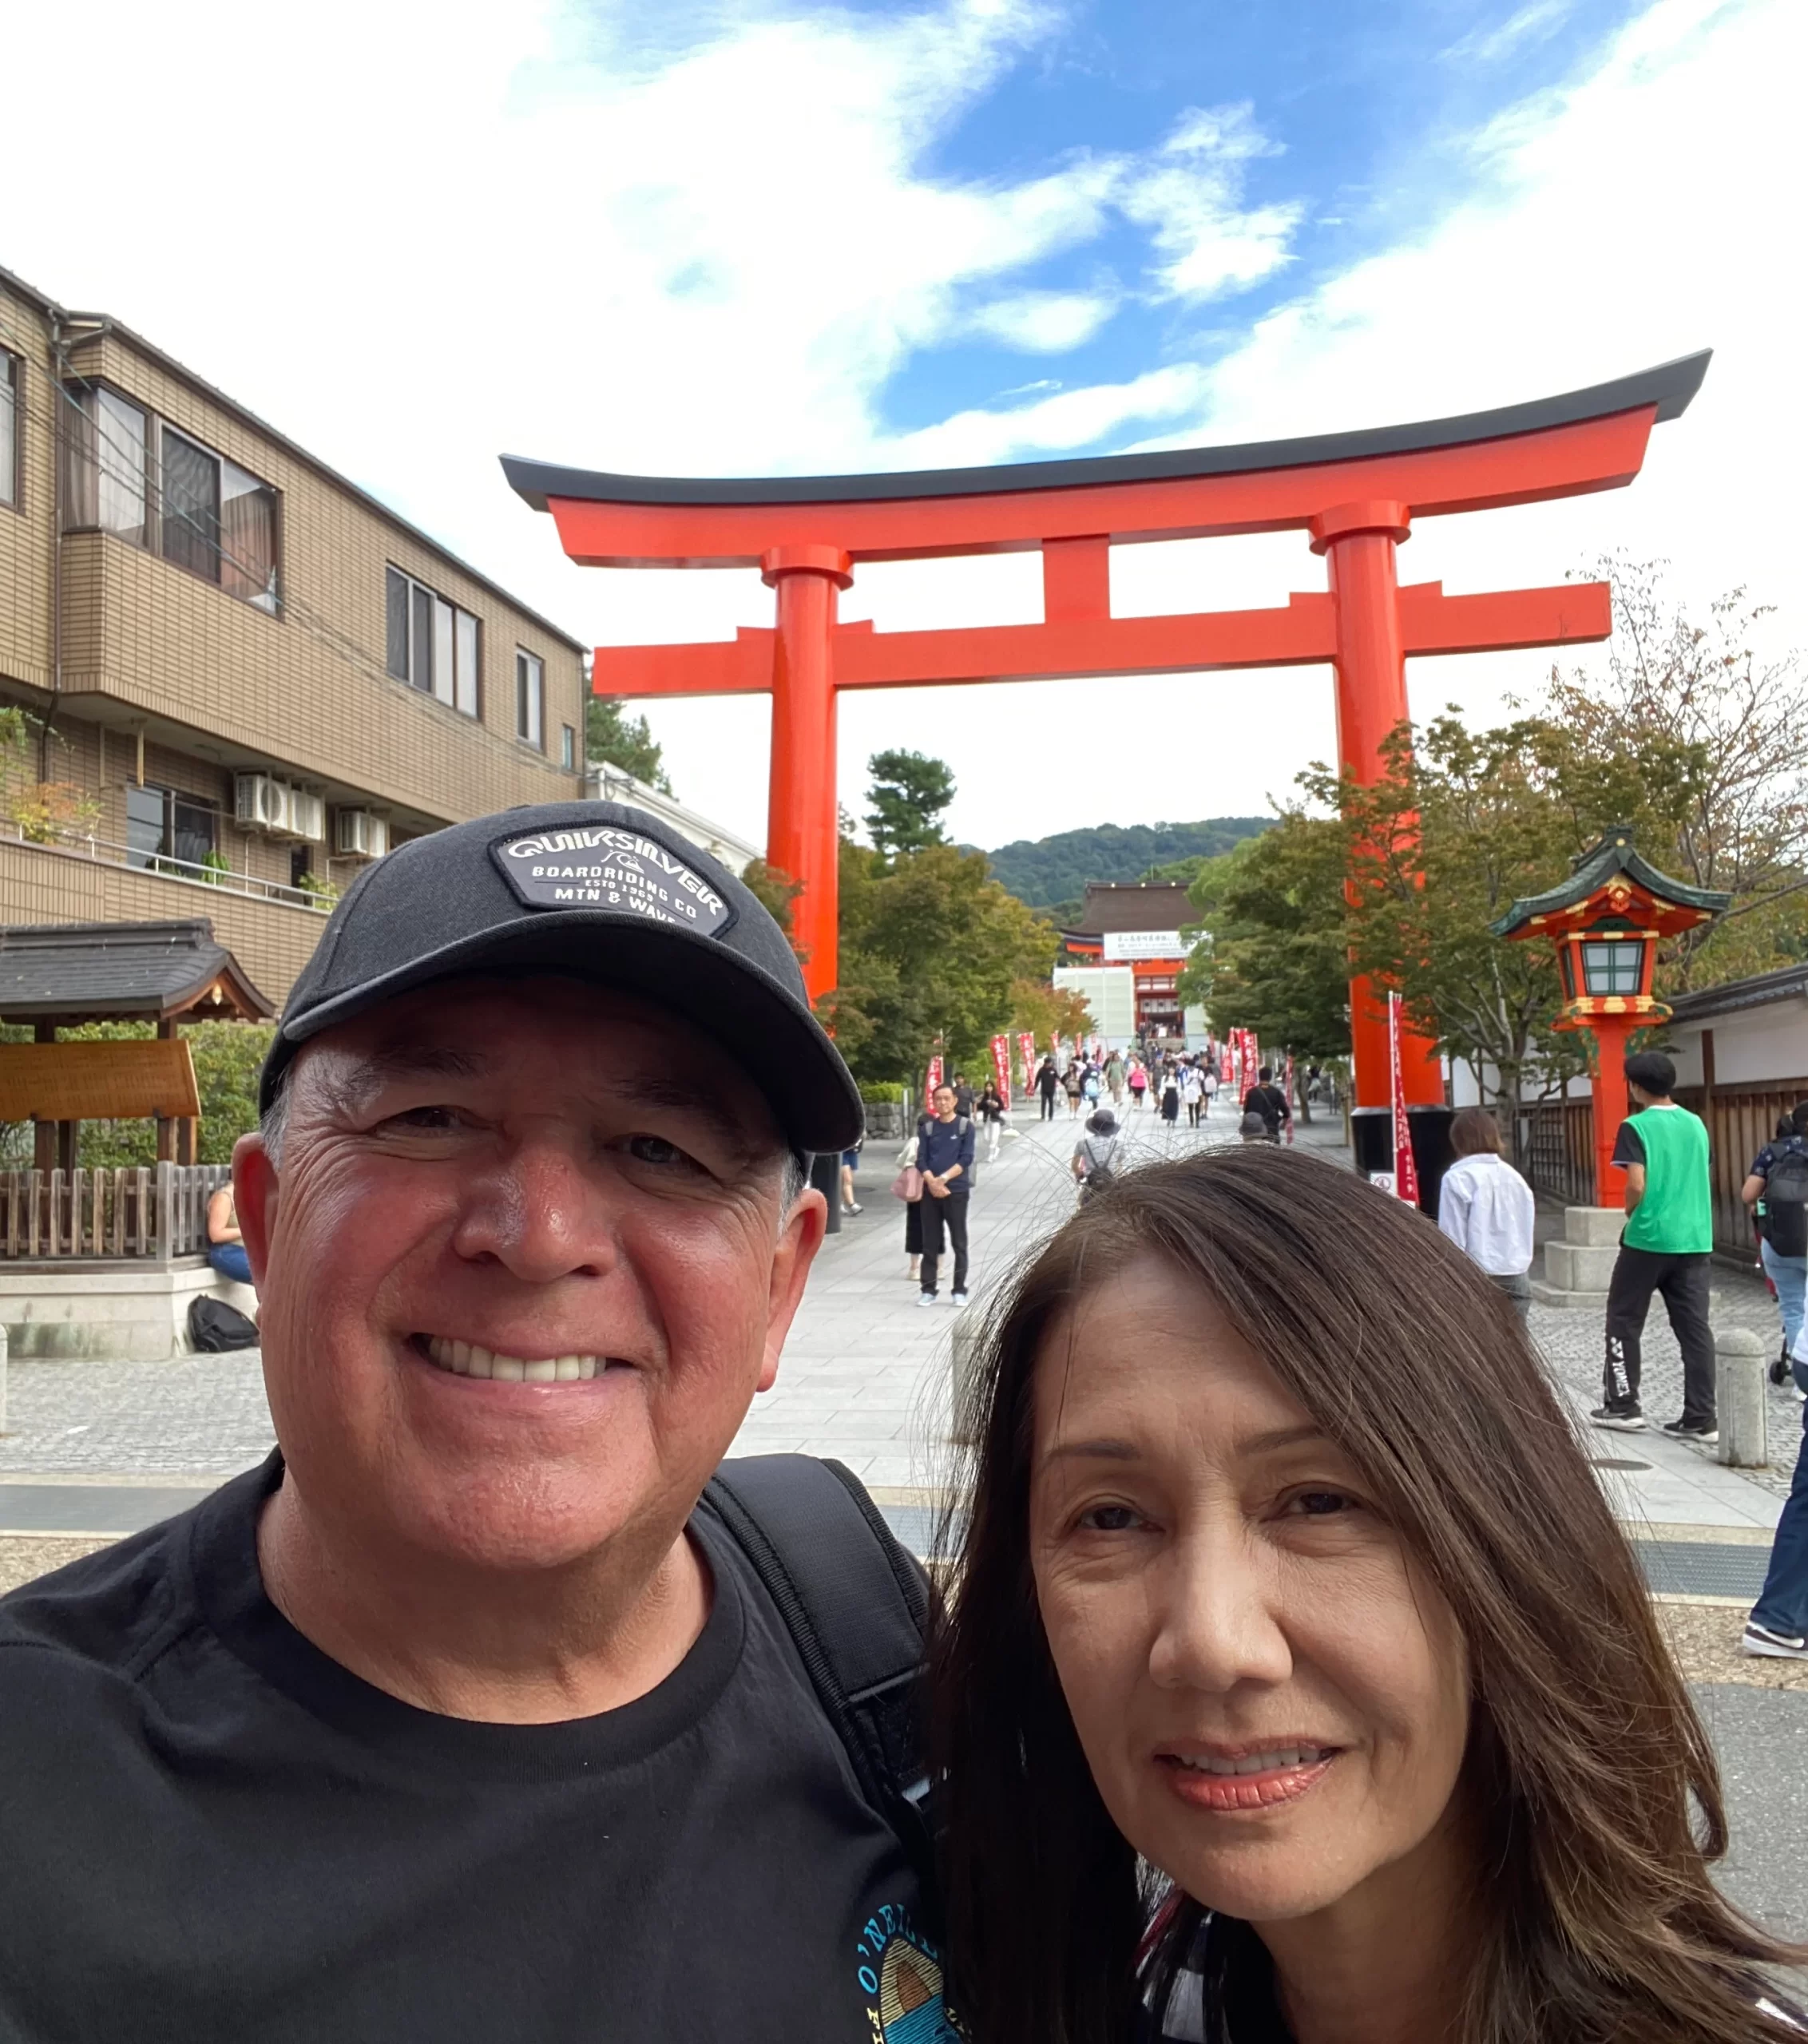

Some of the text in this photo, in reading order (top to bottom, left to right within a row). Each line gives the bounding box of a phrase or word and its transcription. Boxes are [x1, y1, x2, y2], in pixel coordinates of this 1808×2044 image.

[508, 830, 724, 917] QUIKSILVER
[532, 866, 697, 918] BOARDRIDING CO
[555, 888, 601, 901] MTN
[608, 891, 621, 904] &
[622, 884, 654, 902] 1969
[857, 1903, 938, 1994] O'NEILL
